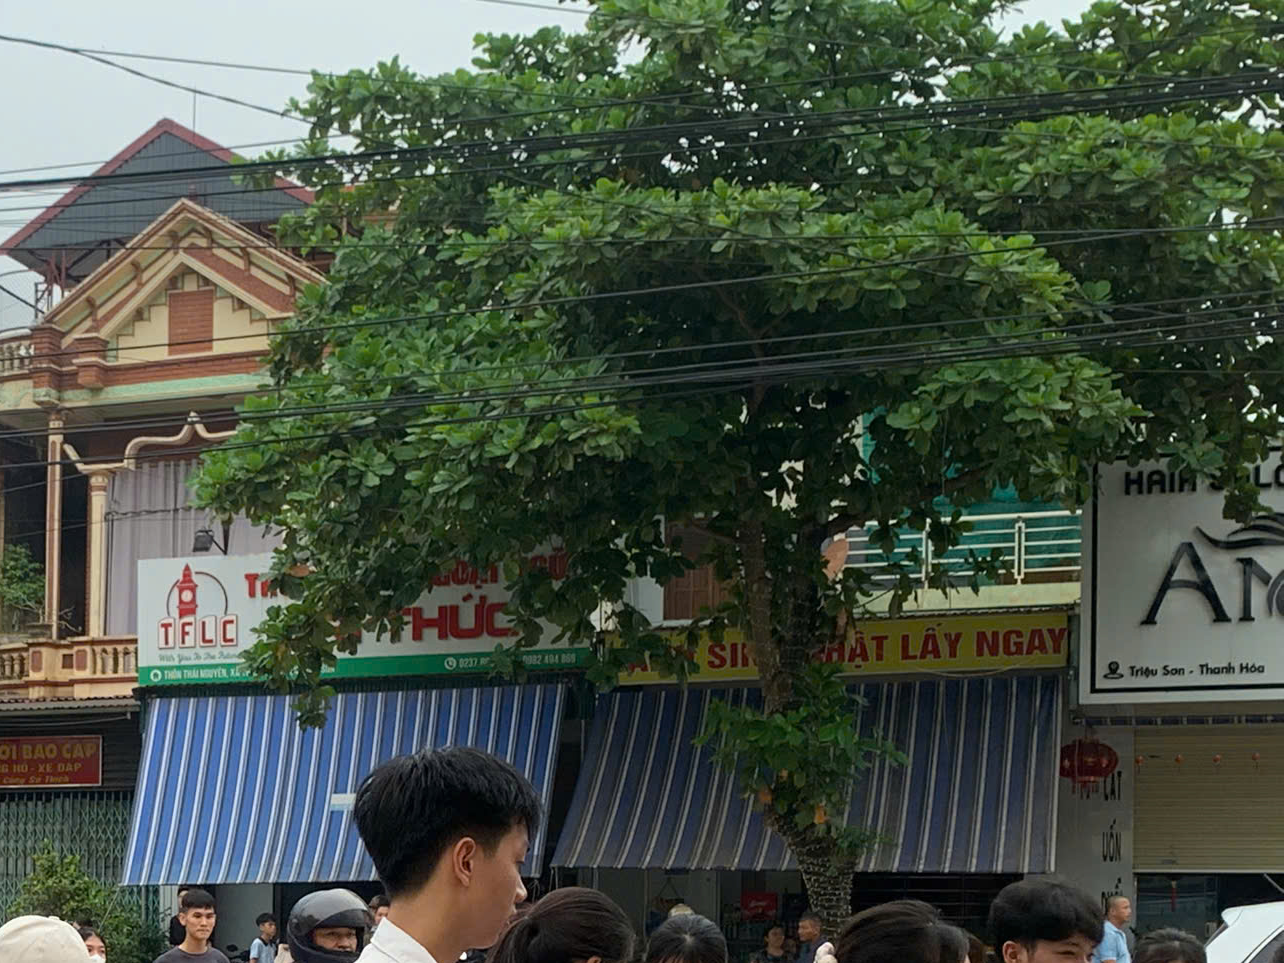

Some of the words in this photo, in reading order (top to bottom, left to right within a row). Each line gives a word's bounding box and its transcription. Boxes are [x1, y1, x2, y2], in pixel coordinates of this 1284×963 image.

[160, 619, 235, 646] TFLC
[400, 594, 519, 642] HỨC
[900, 622, 964, 661] LẤY
[975, 627, 1068, 658] NGAY
[1129, 666, 1157, 678] Triệu
[1199, 662, 1235, 676] Thanh
[1240, 661, 1265, 674] Hóa
